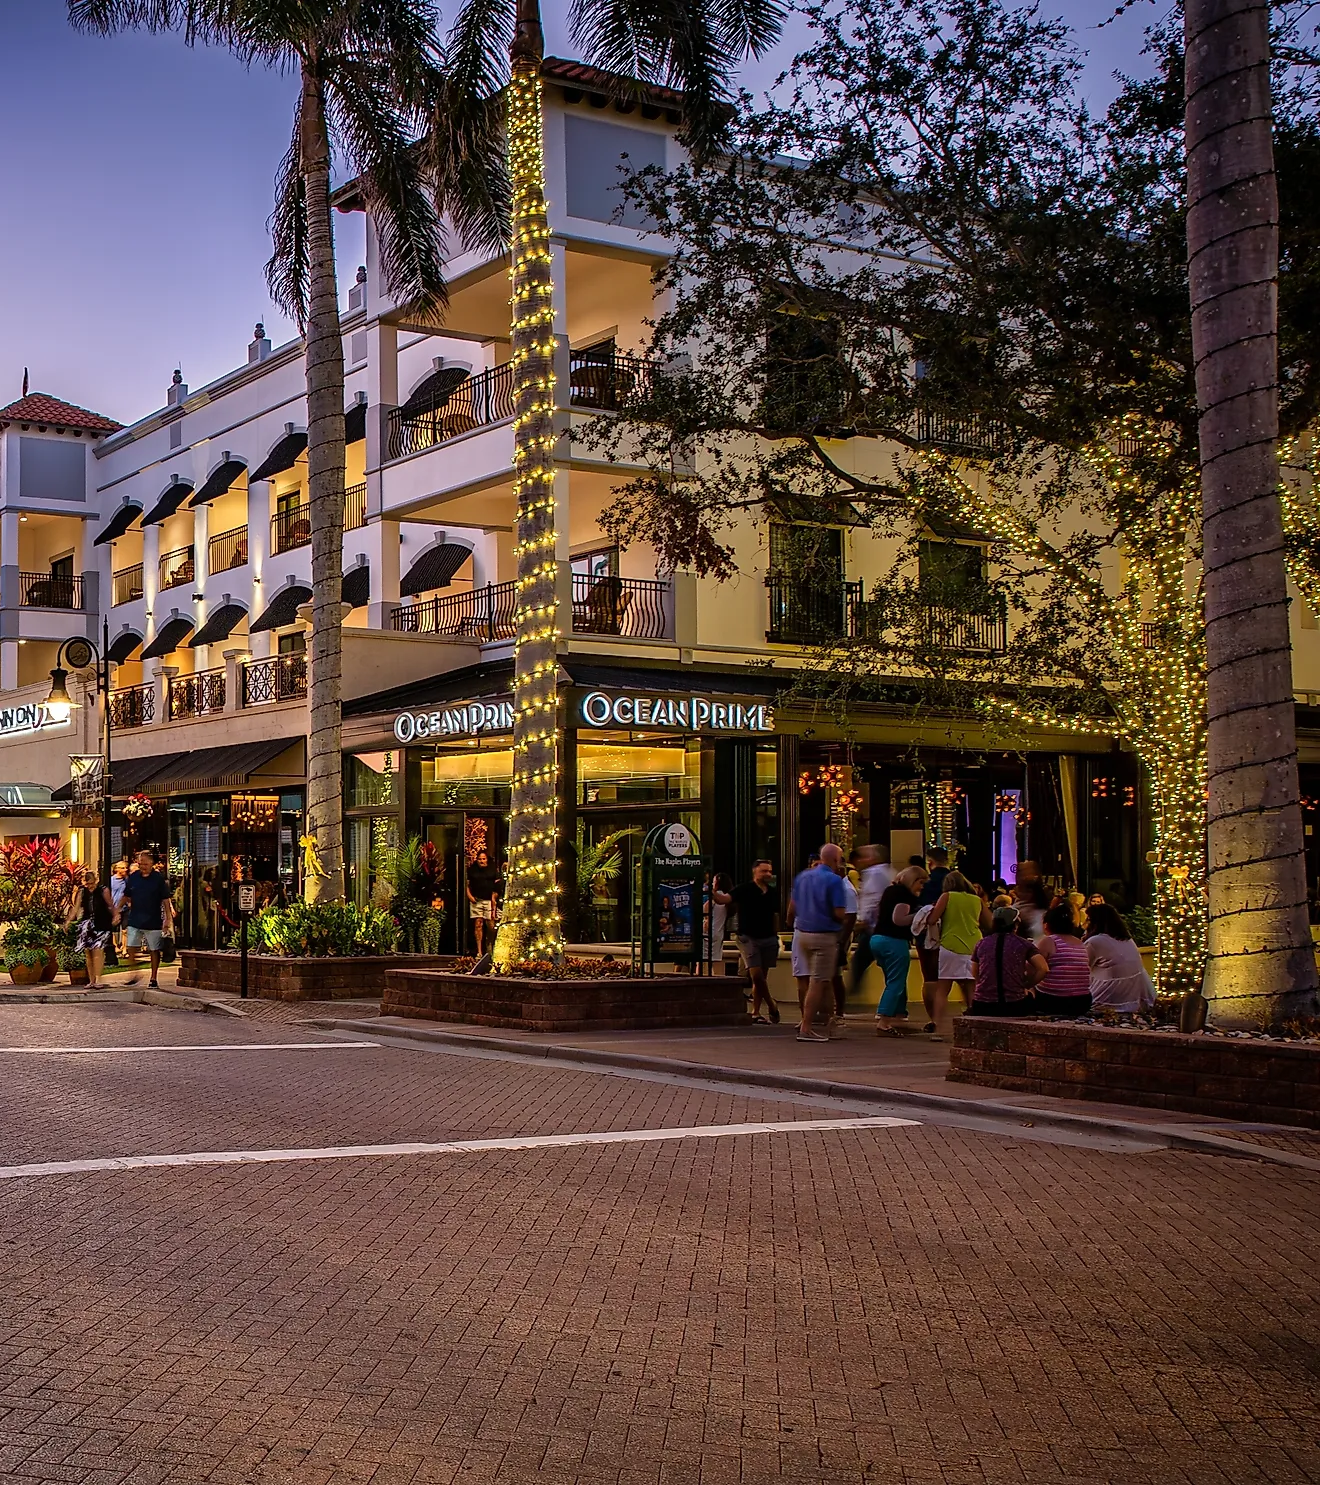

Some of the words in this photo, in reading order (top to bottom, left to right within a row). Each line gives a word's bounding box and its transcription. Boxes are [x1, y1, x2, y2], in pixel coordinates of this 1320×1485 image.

[394, 708, 468, 743] OCEAN
[583, 691, 689, 727] OCEAN
[691, 697, 776, 731] PRIME
